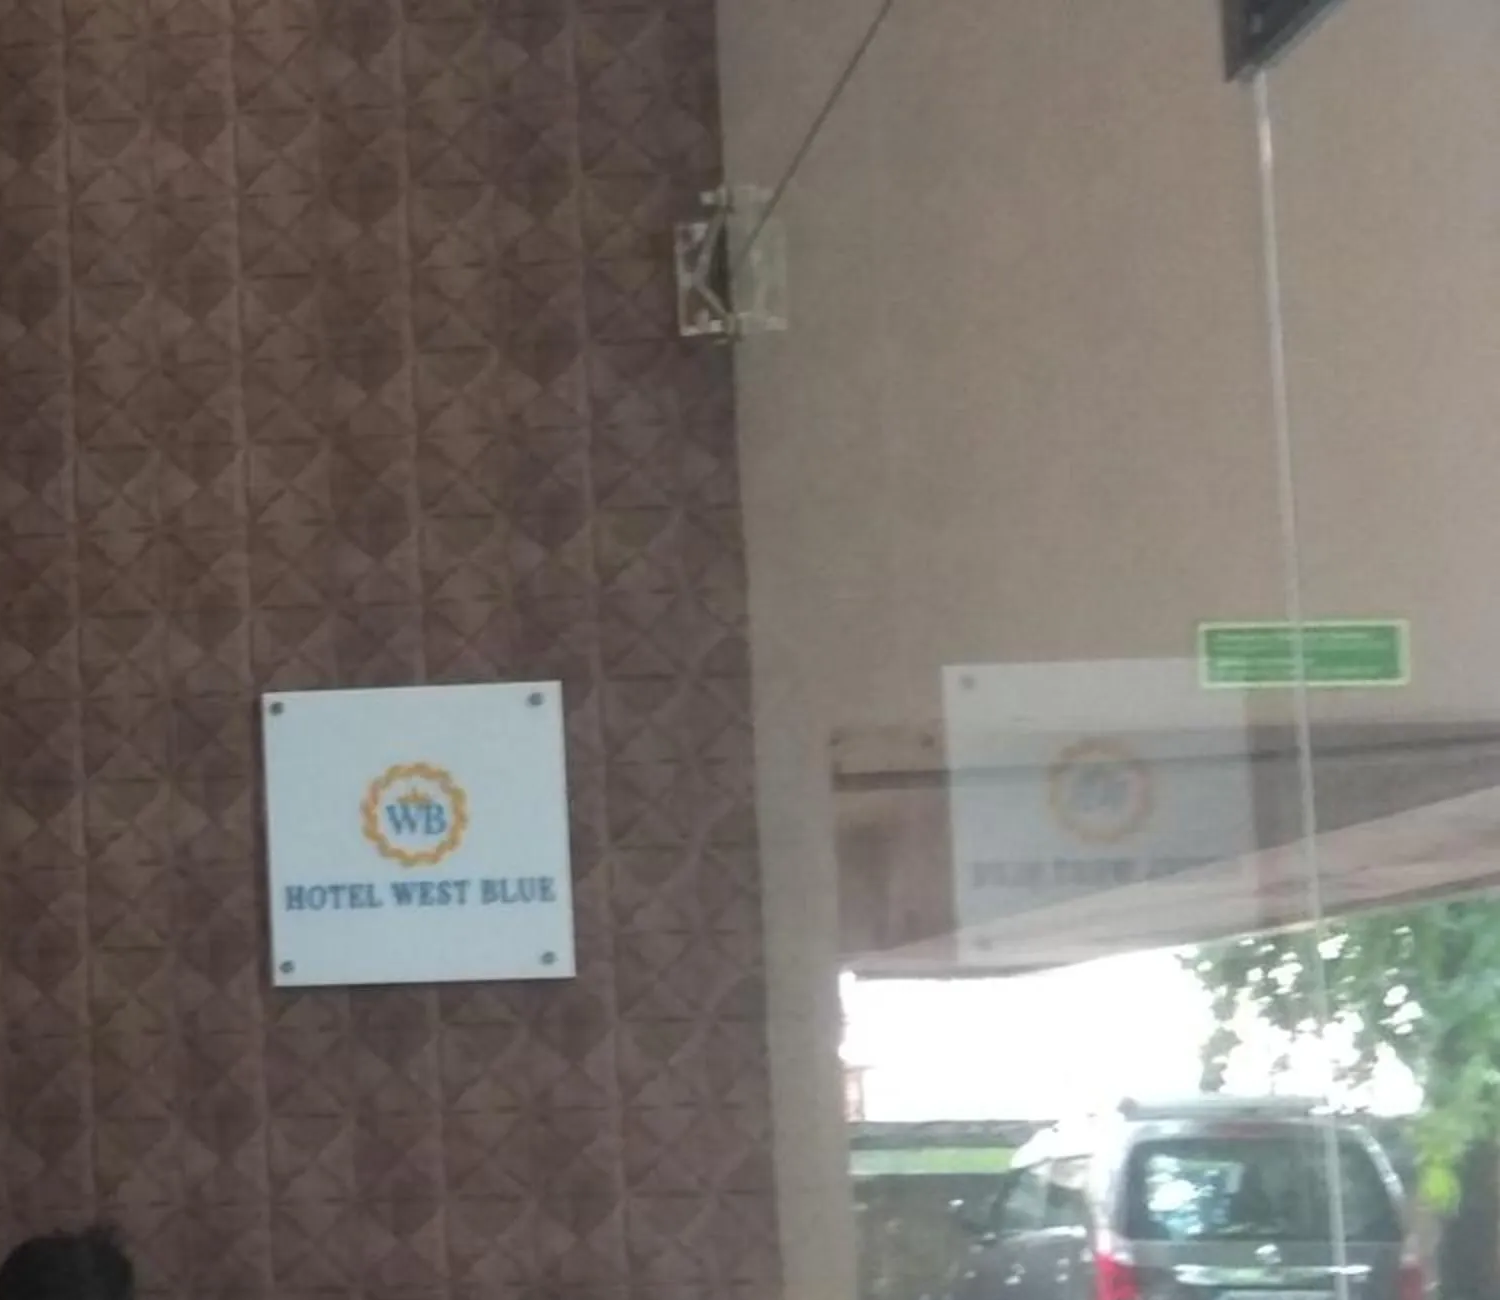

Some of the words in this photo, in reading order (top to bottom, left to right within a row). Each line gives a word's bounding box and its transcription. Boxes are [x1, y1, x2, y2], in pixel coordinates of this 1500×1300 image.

[386, 803, 447, 835] WB
[285, 883, 383, 911] HOTEL
[391, 880, 470, 906] WEST
[480, 877, 557, 904] BLUE
